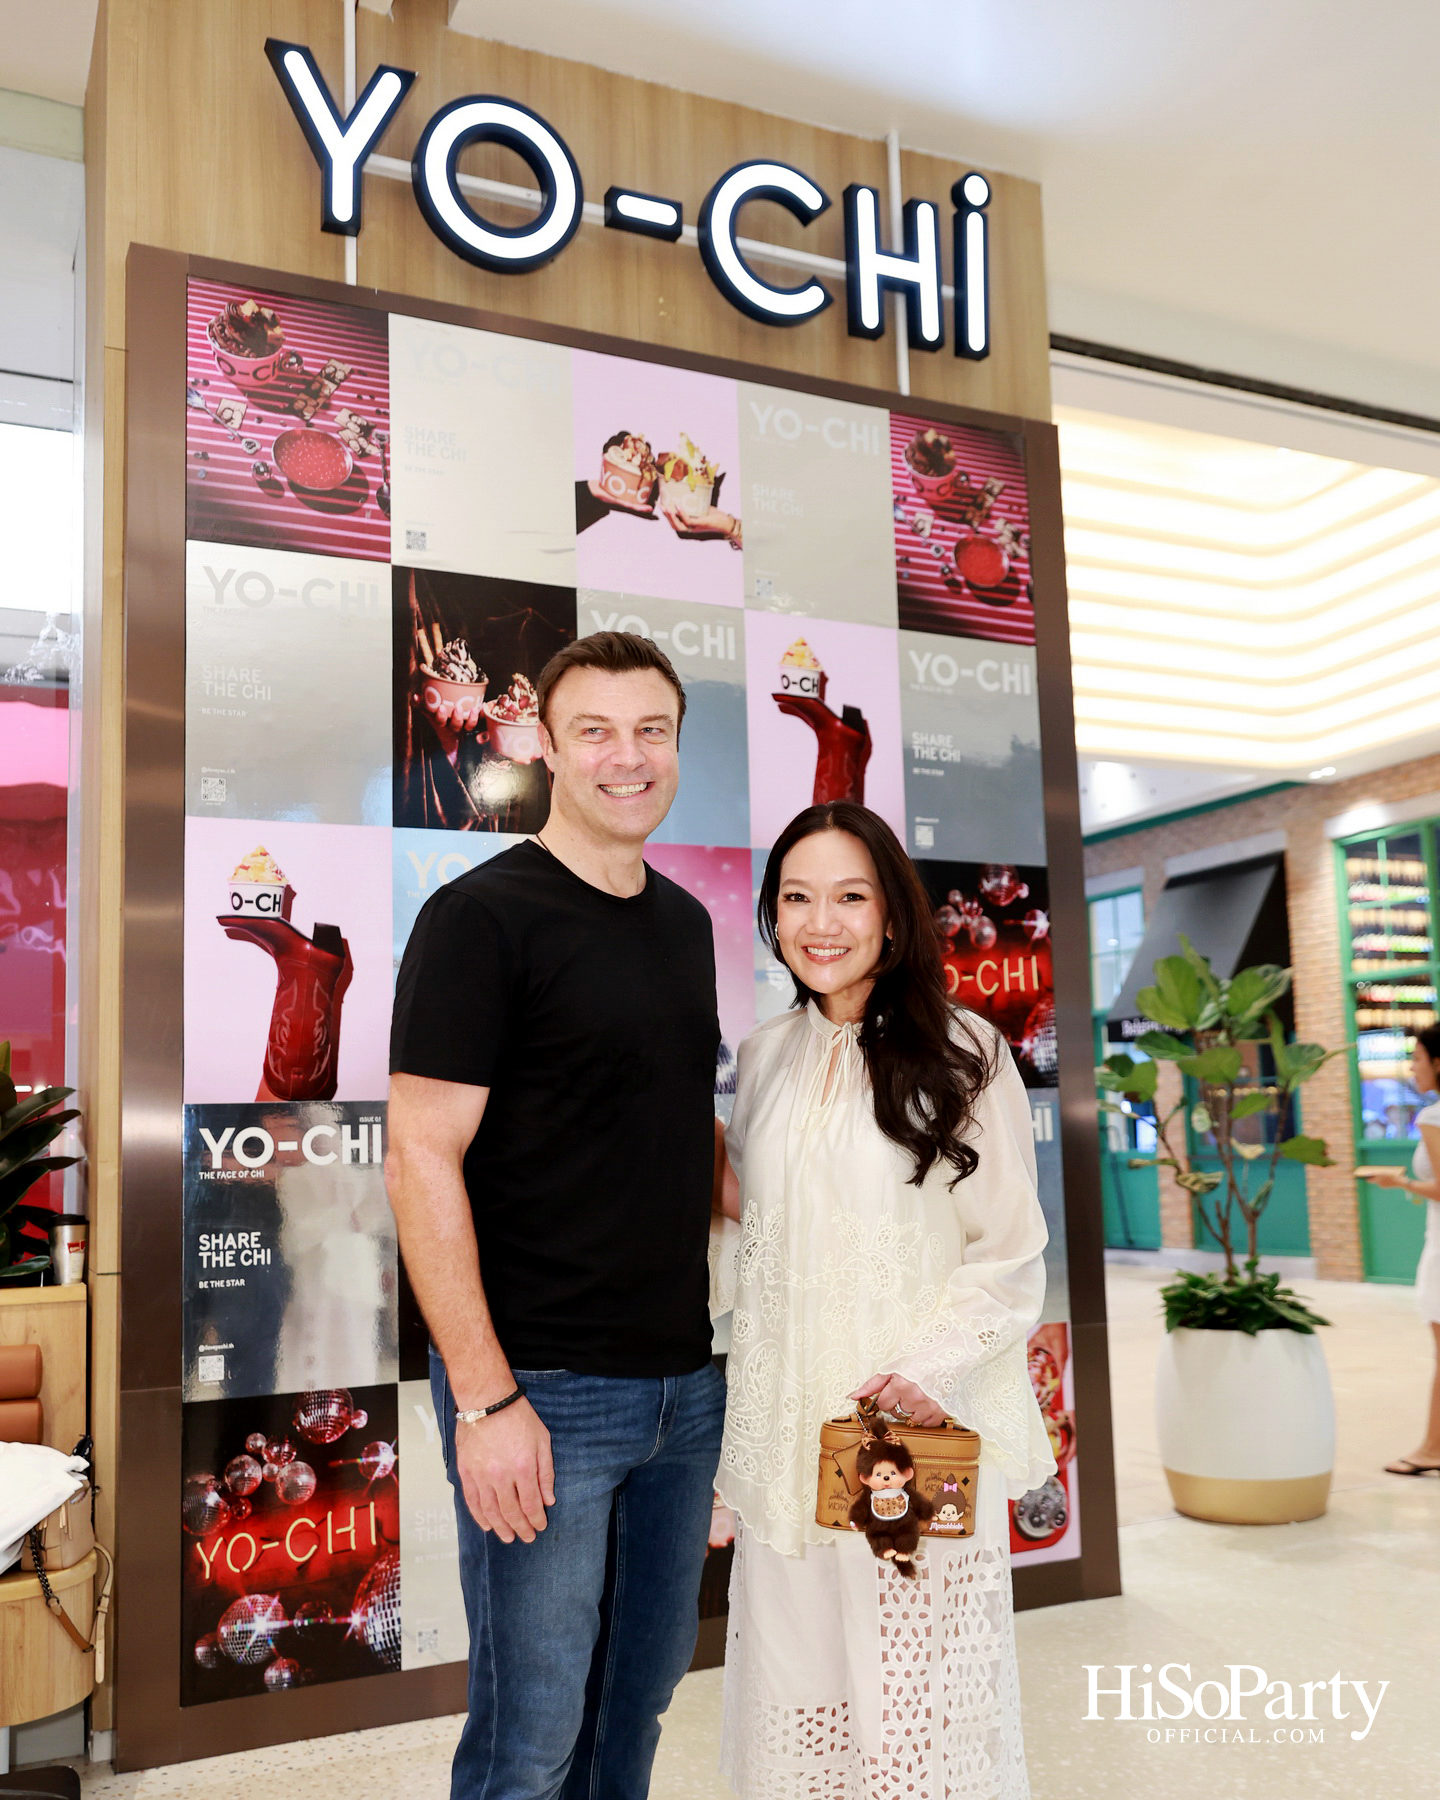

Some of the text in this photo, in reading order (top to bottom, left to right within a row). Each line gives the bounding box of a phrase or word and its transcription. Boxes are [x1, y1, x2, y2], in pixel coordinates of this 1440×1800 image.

[404, 425, 457, 446] SHARE
[750, 401, 880, 456] YO-CHI
[404, 440, 467, 462] THE CHI
[752, 496, 804, 516] THE CHI
[202, 565, 379, 615] YO-CHI
[202, 664, 262, 684] SHARE
[909, 650, 1032, 696] YO-CHI
[202, 680, 272, 701] THE CHI
[212, 707, 227, 716] THE
[912, 731, 953, 748] SHARE
[912, 744, 961, 762] THE CHI
[943, 954, 1039, 996] O-CHI
[199, 1124, 382, 1169] YO-CHI
[199, 1169, 264, 1180] THE FACE OF CHI
[199, 1231, 261, 1251] SHARE
[198, 1248, 271, 1268] THE CHI
[199, 1278, 246, 1289] BE THE STAR
[414, 1507, 456, 1526] SHA
[929, 1521, 965, 1531] Monchhichi
[196, 1501, 376, 1579] YO-CHI
[414, 1523, 448, 1543] THE
